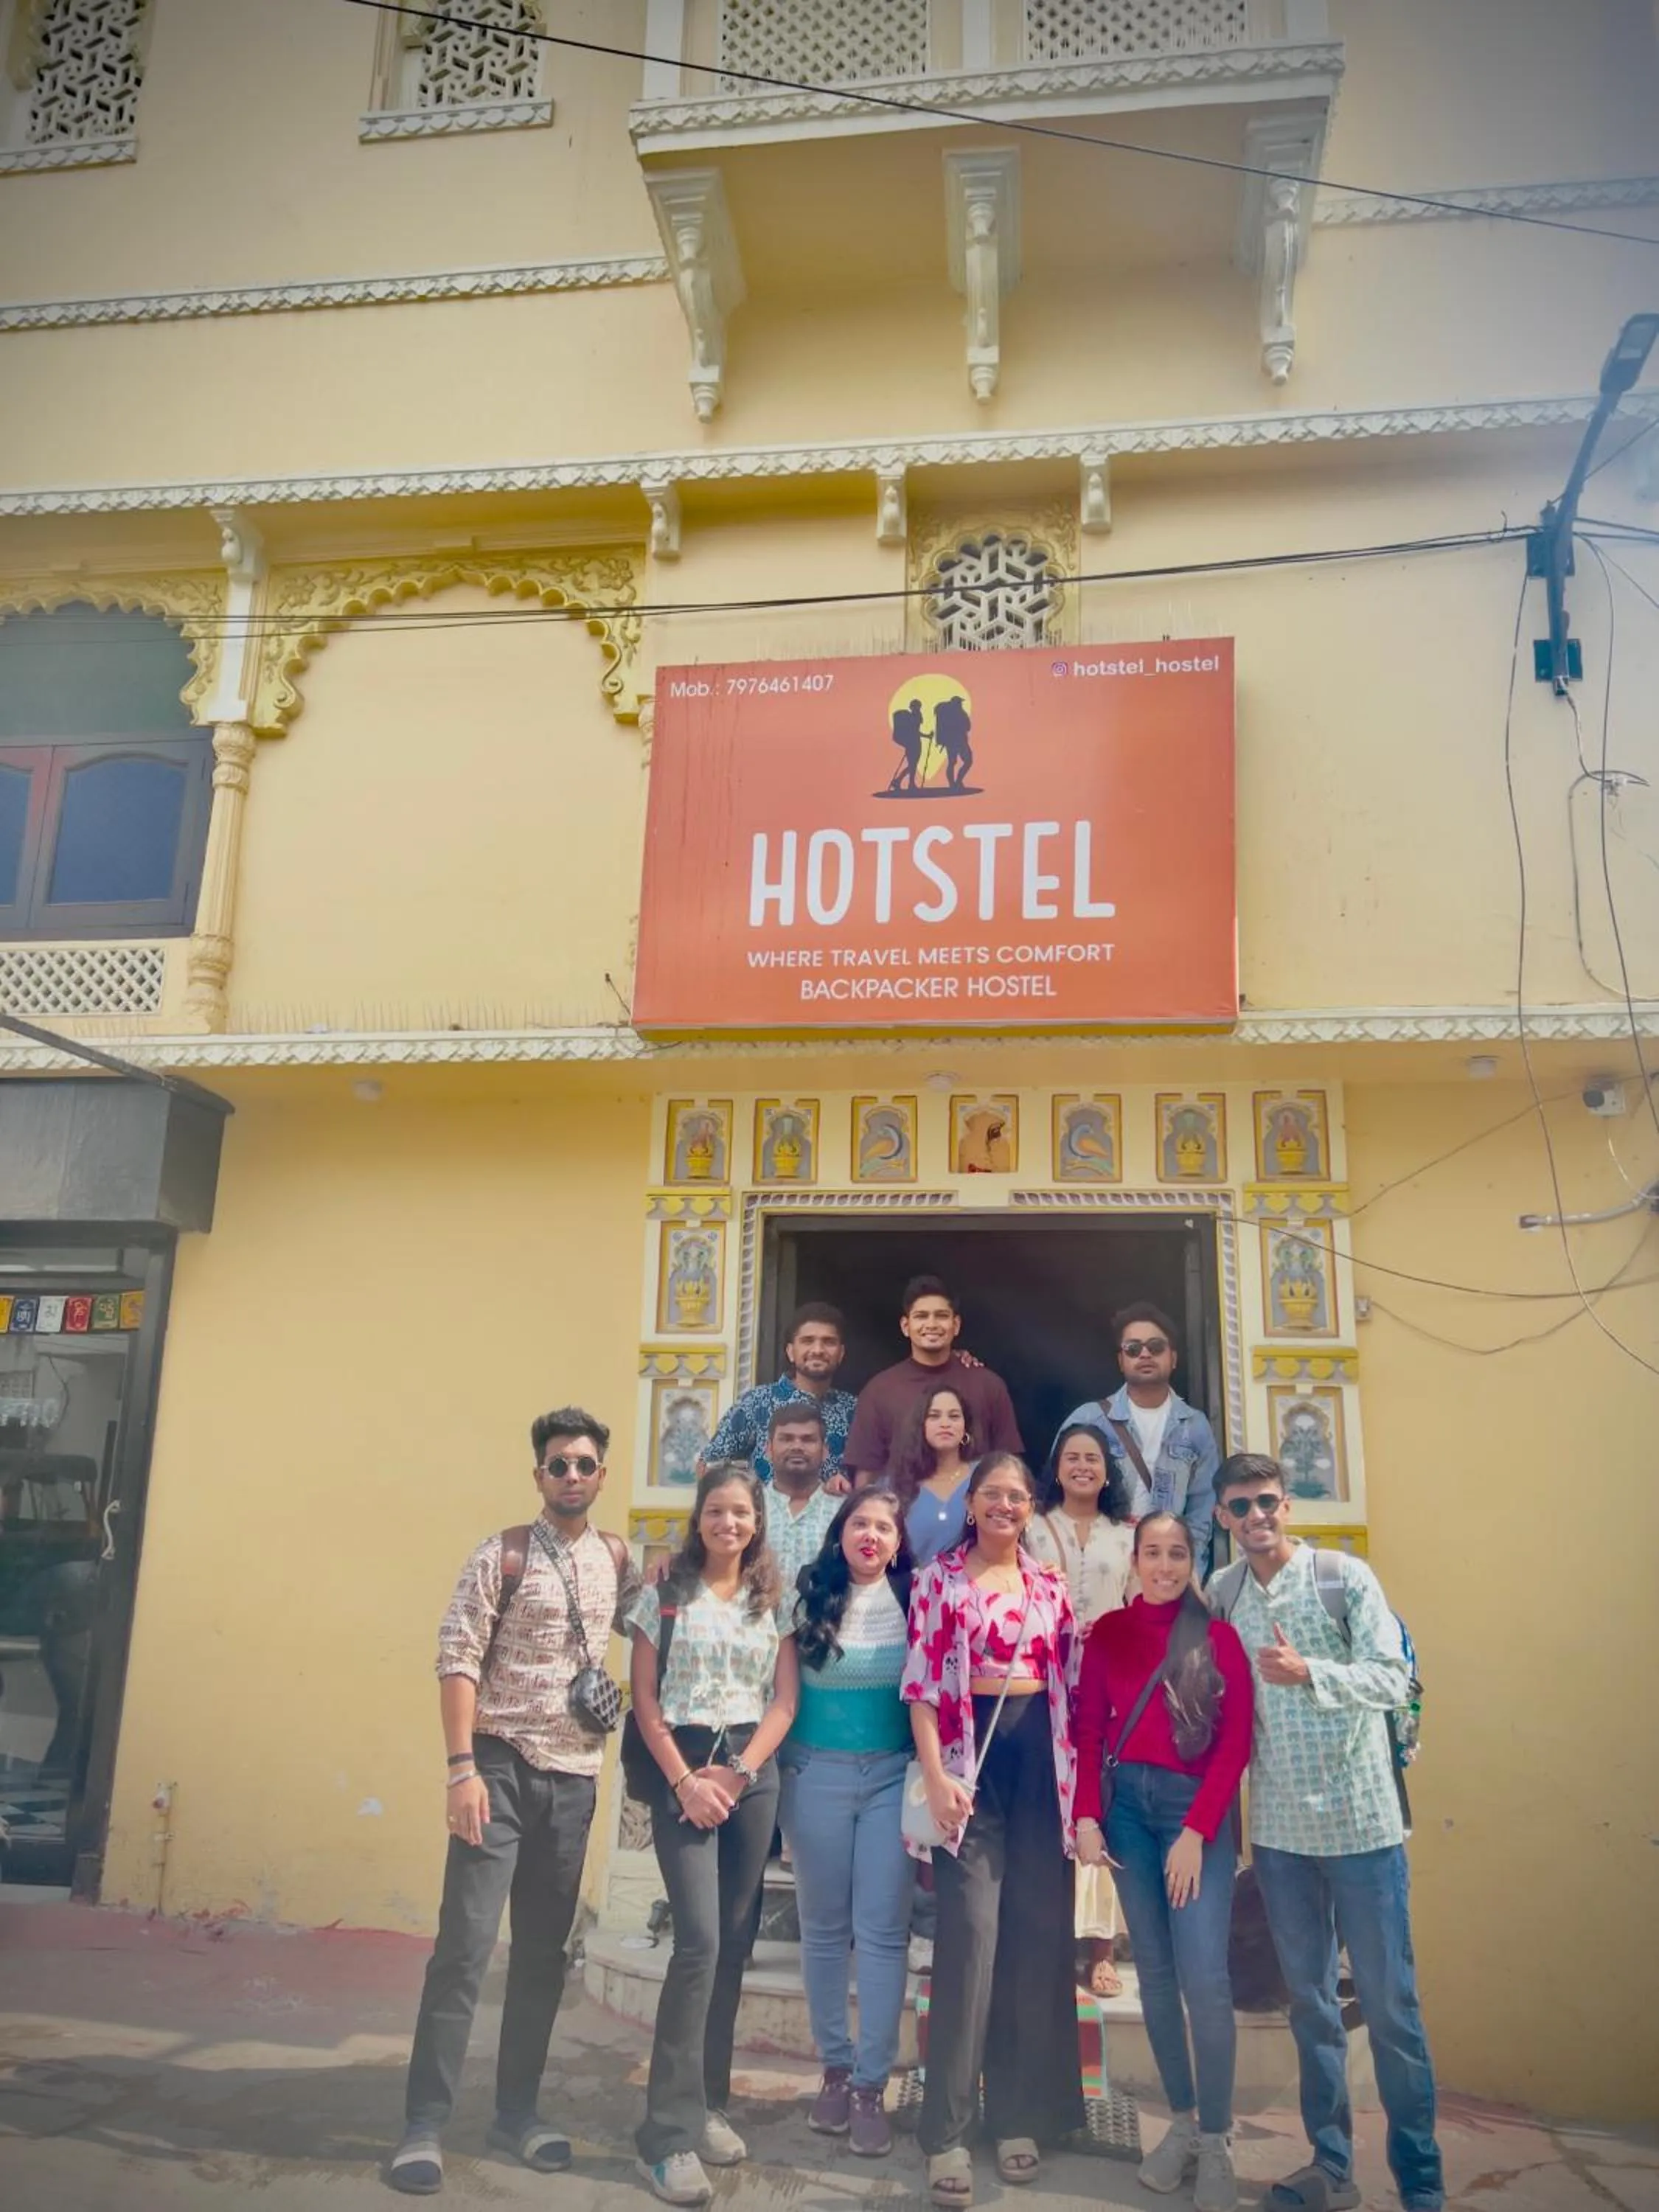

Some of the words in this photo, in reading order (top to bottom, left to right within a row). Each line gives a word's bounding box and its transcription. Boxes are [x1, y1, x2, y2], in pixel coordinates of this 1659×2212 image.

[1073, 654, 1220, 678] hotstel_hostel
[726, 674, 835, 696] 7976461407
[748, 819, 1116, 928] HOTSTEL
[747, 950, 823, 968] WHERE
[830, 948, 911, 966] TRAVEL
[918, 947, 990, 965] MEETS
[995, 943, 1116, 963] COMFORT
[800, 976, 959, 1001] BACKPACKER
[967, 975, 1057, 998] HOSTEL
